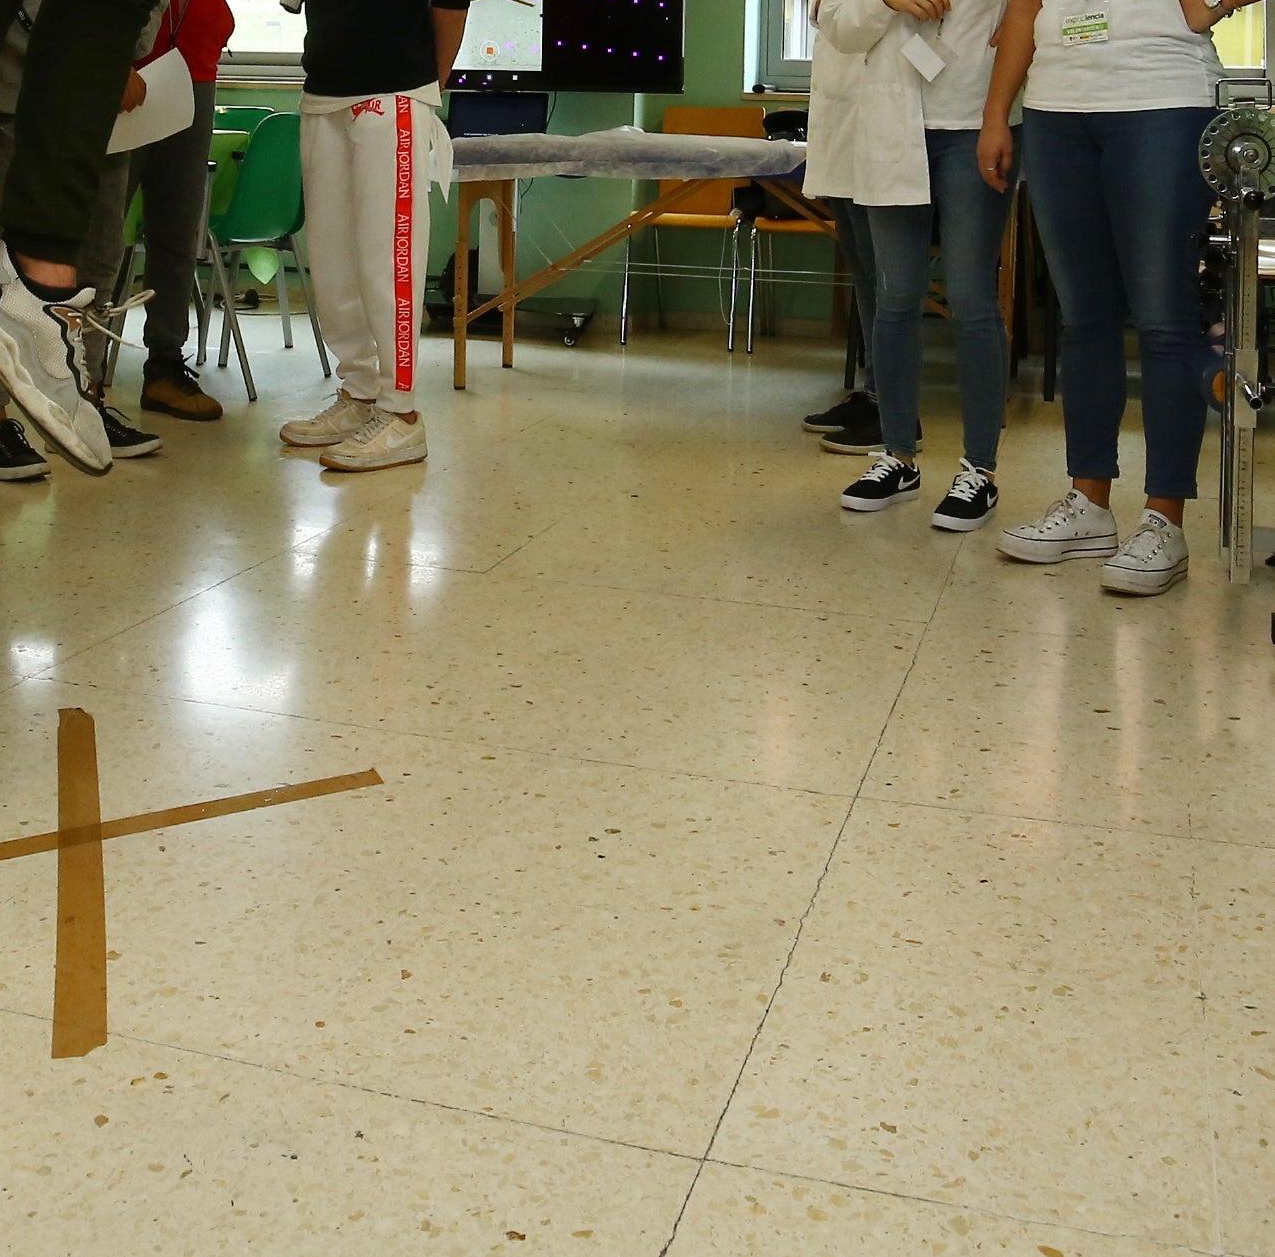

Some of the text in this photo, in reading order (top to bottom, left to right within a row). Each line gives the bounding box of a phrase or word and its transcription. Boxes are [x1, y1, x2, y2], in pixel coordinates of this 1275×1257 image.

[398, 129, 411, 198] AIR JORDAN
[397, 214, 409, 282] AIR JORDAN
[398, 298, 410, 367] AIR JORDAN
